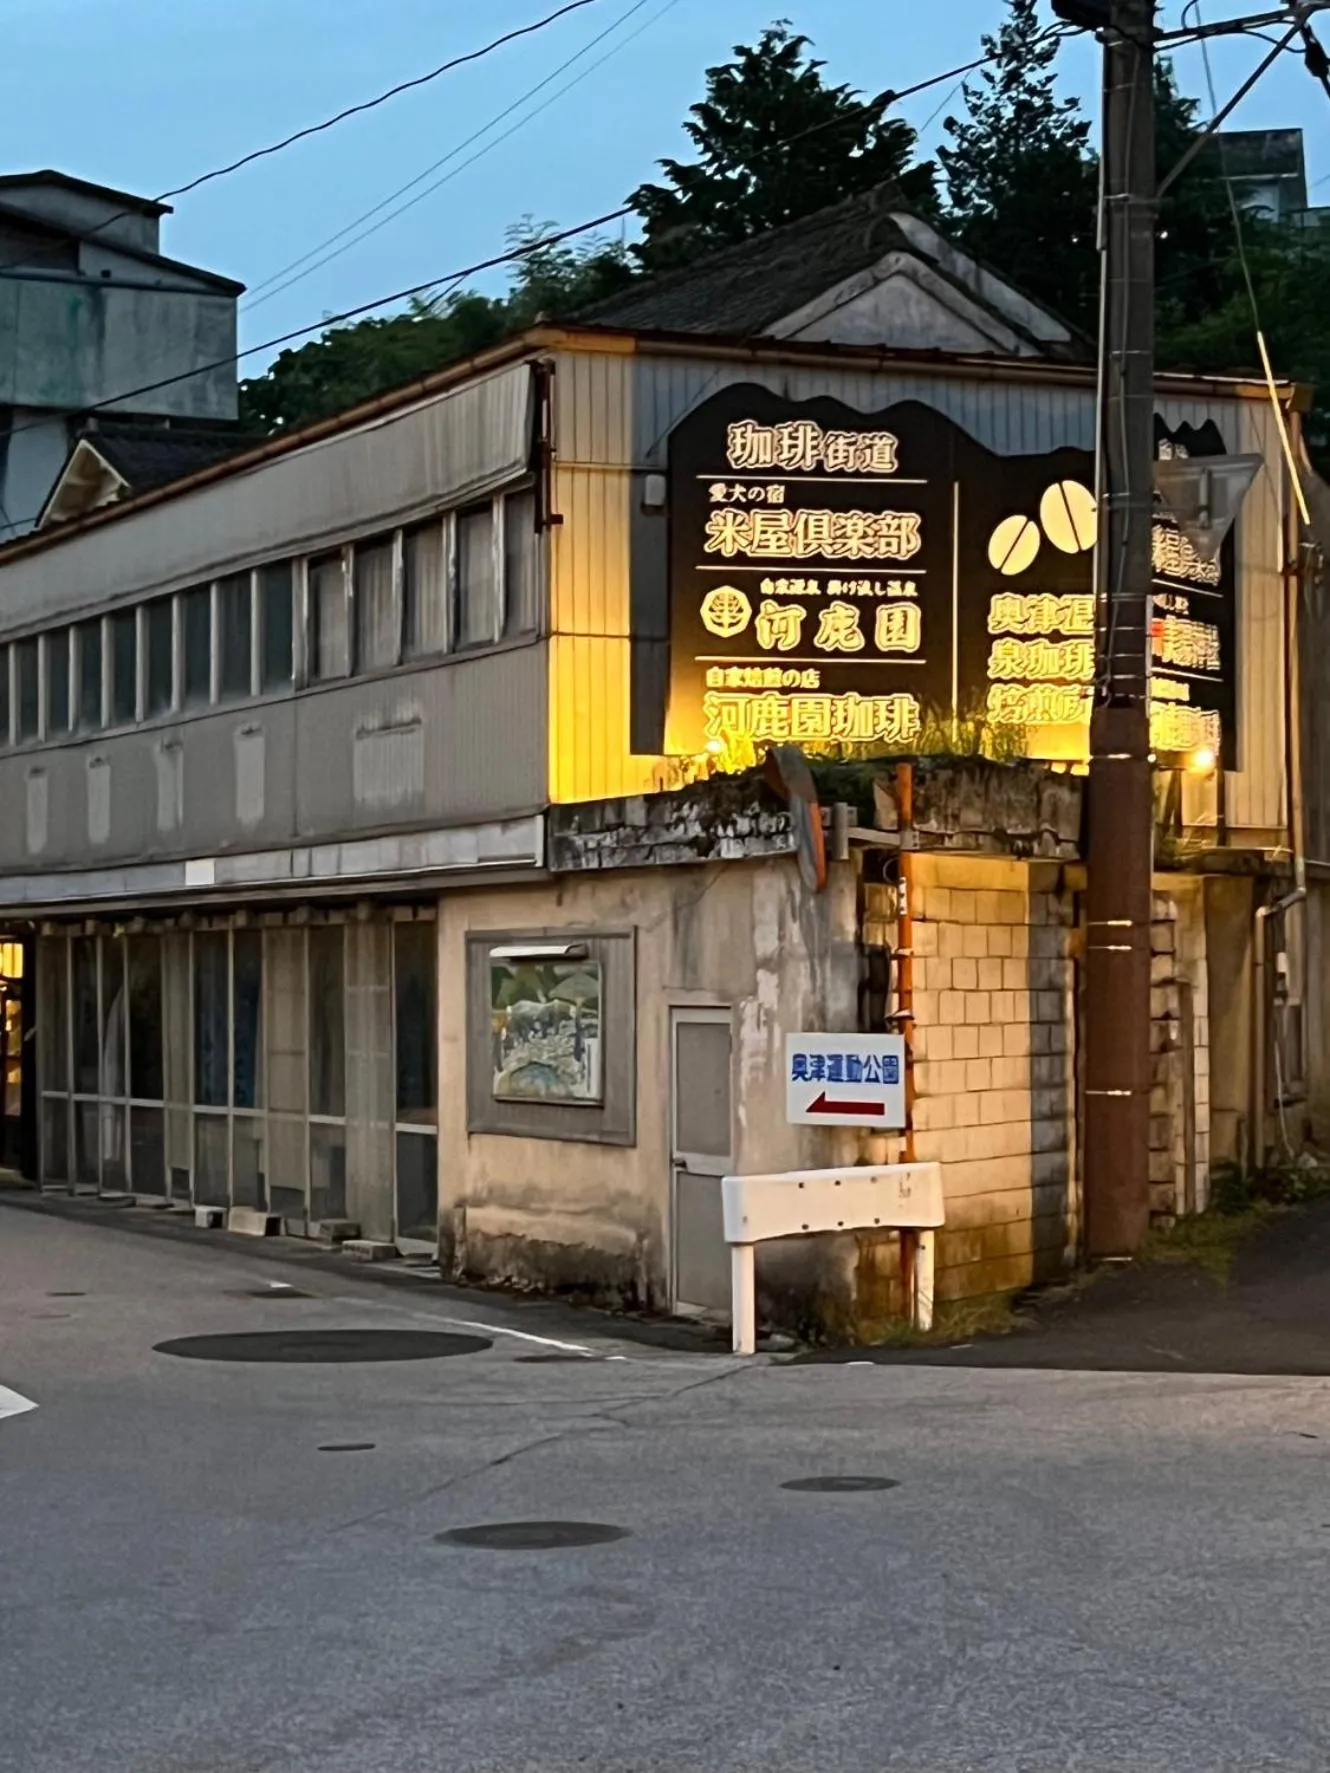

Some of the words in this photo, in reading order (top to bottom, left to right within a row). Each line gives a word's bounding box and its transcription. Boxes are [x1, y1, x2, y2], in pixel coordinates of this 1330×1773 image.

[728, 420, 897, 473] 珈琲街道
[705, 509, 922, 560] 米屋倶楽部
[705, 692, 921, 742] 河鹿園珈琲
[792, 1053, 899, 1084] 奥津運動公園
